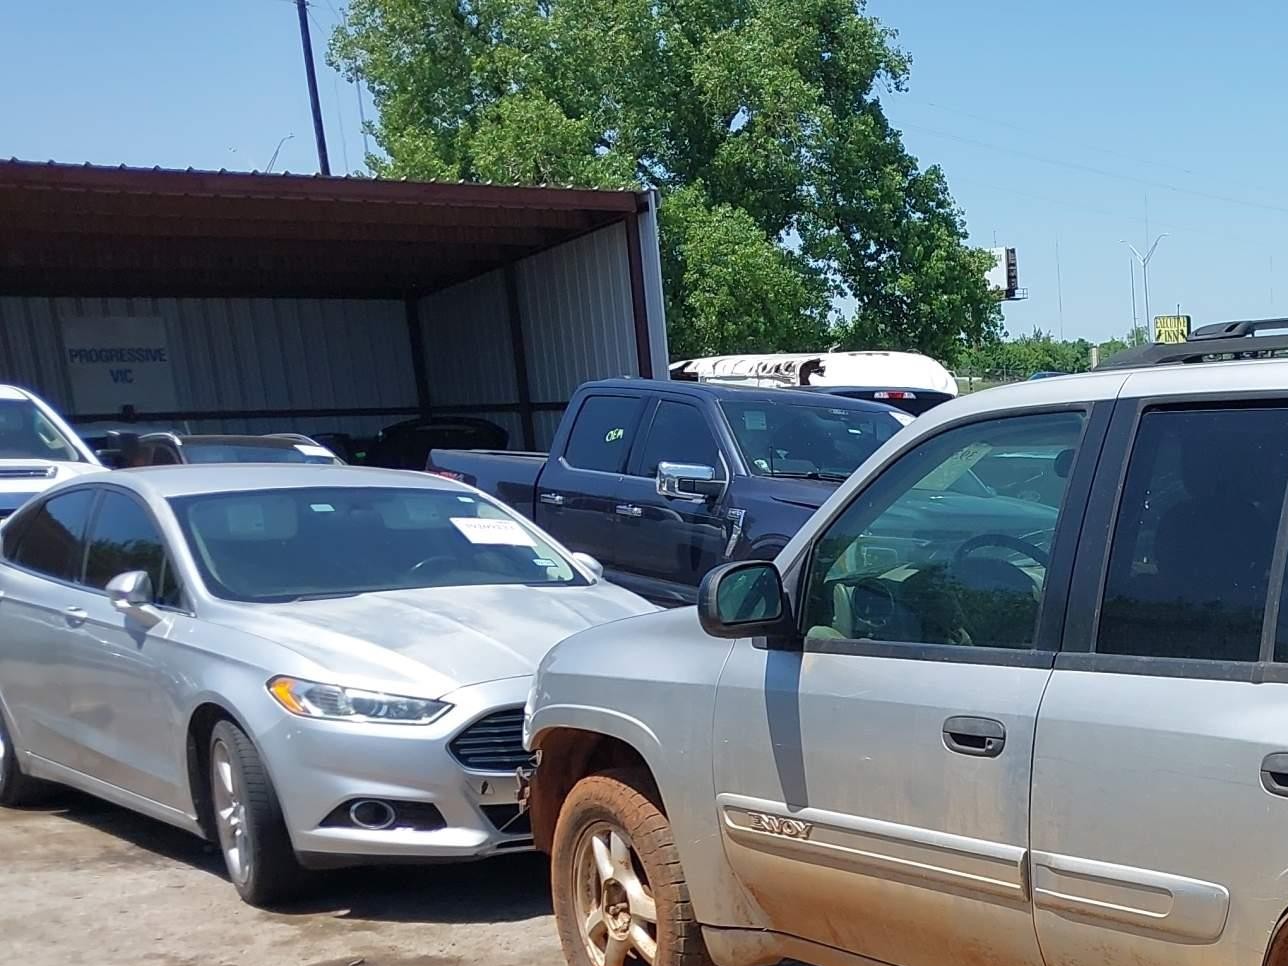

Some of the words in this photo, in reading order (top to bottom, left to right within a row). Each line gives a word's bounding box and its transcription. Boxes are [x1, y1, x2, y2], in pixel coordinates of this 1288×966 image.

[1155, 316, 1186, 329] EXECUTIVE
[1164, 329, 1180, 343] INN
[68, 348, 167, 363] PROGRESSIVE
[109, 368, 134, 384] VIC
[748, 811, 814, 840] ENVOY
